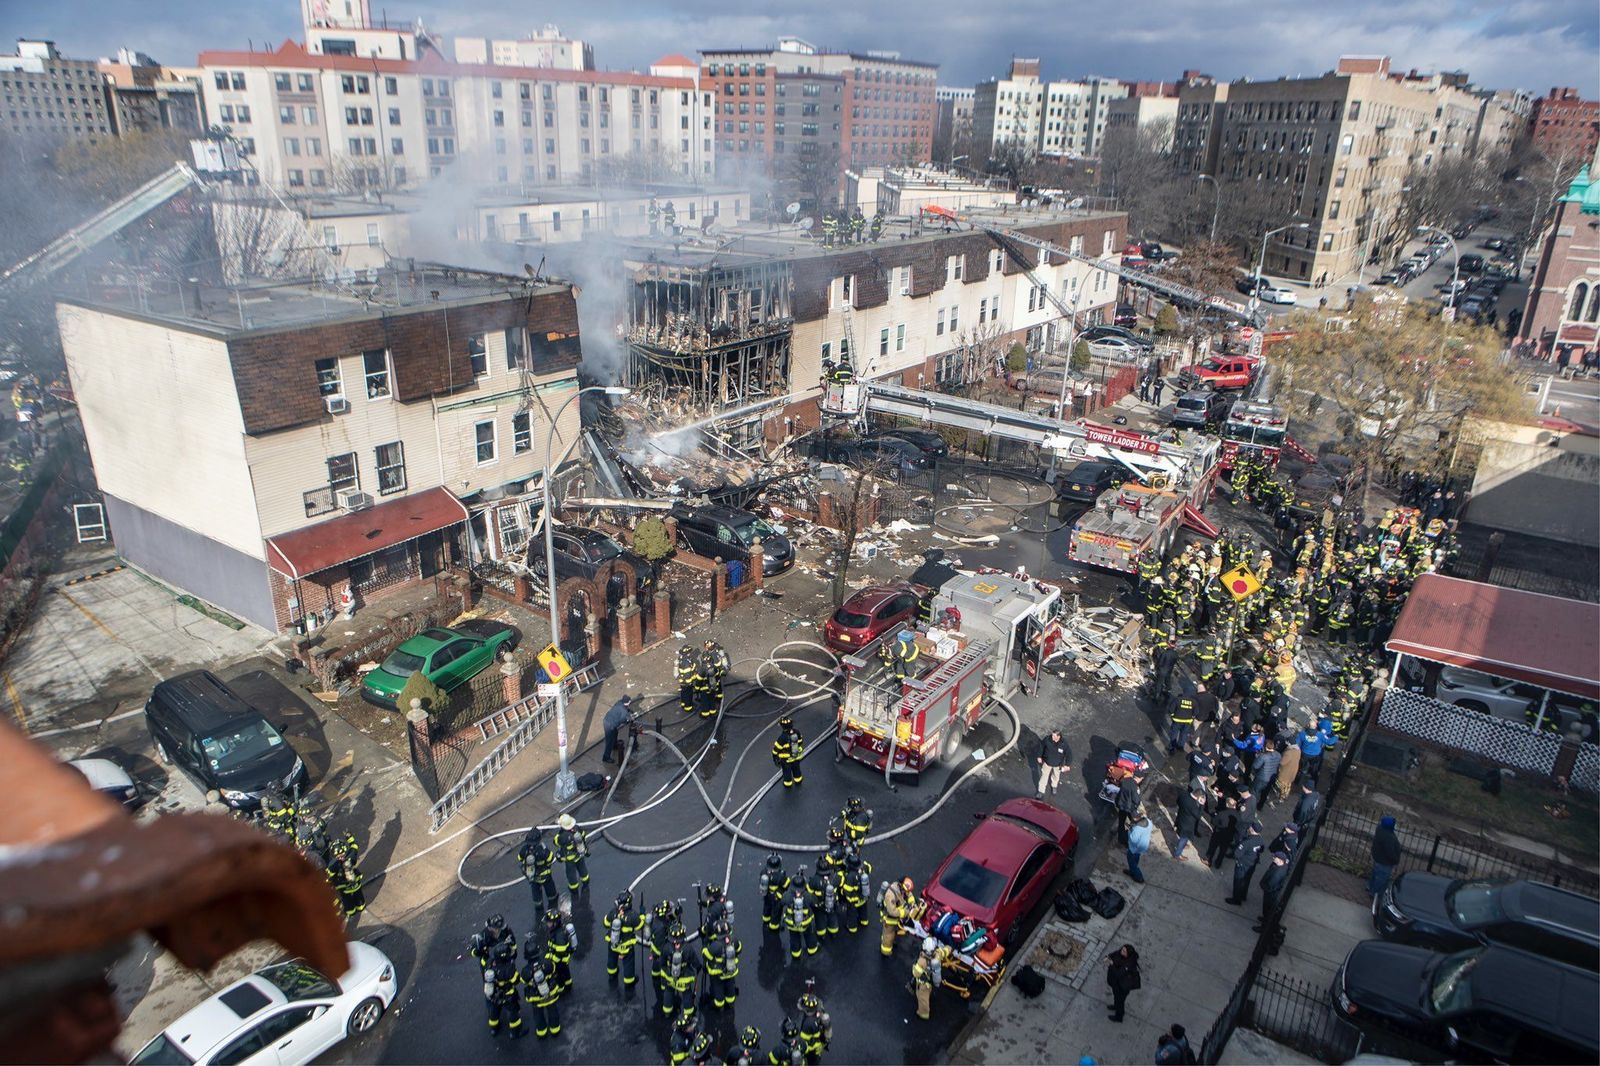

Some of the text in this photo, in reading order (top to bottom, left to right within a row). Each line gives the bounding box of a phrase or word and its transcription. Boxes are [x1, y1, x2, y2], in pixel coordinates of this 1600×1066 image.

[1089, 431, 1149, 451] TOWER LADDER 31
[1093, 536, 1118, 547] FDNY
[974, 581, 999, 595] 73
[871, 738, 884, 753] 73
